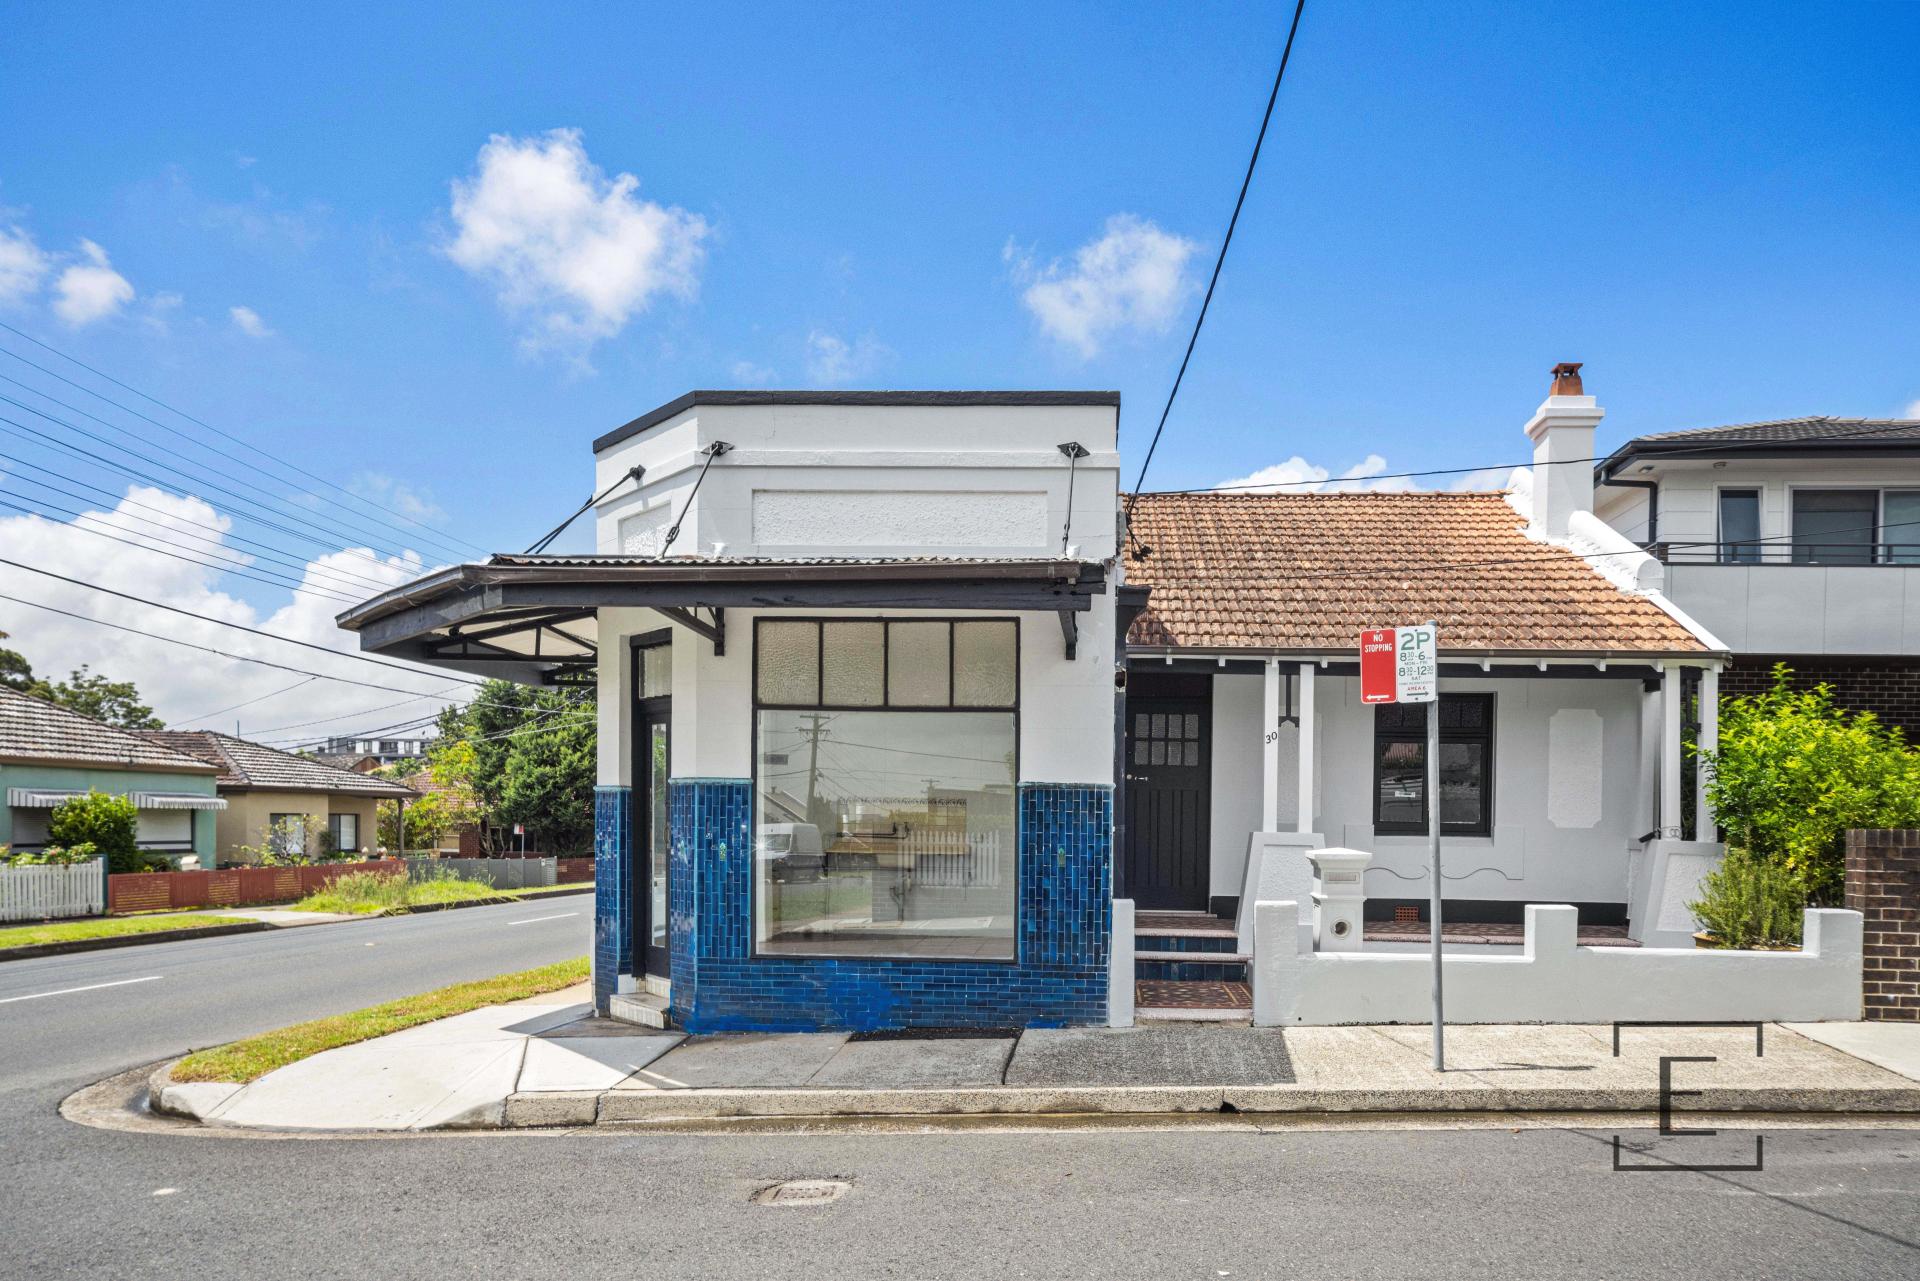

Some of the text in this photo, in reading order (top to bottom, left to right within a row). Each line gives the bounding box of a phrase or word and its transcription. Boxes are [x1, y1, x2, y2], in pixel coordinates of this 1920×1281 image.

[1373, 633, 1383, 642] NO
[1401, 632, 1430, 650] 2P
[1364, 643, 1392, 653] STOPPING
[1266, 731, 1277, 744] 30
